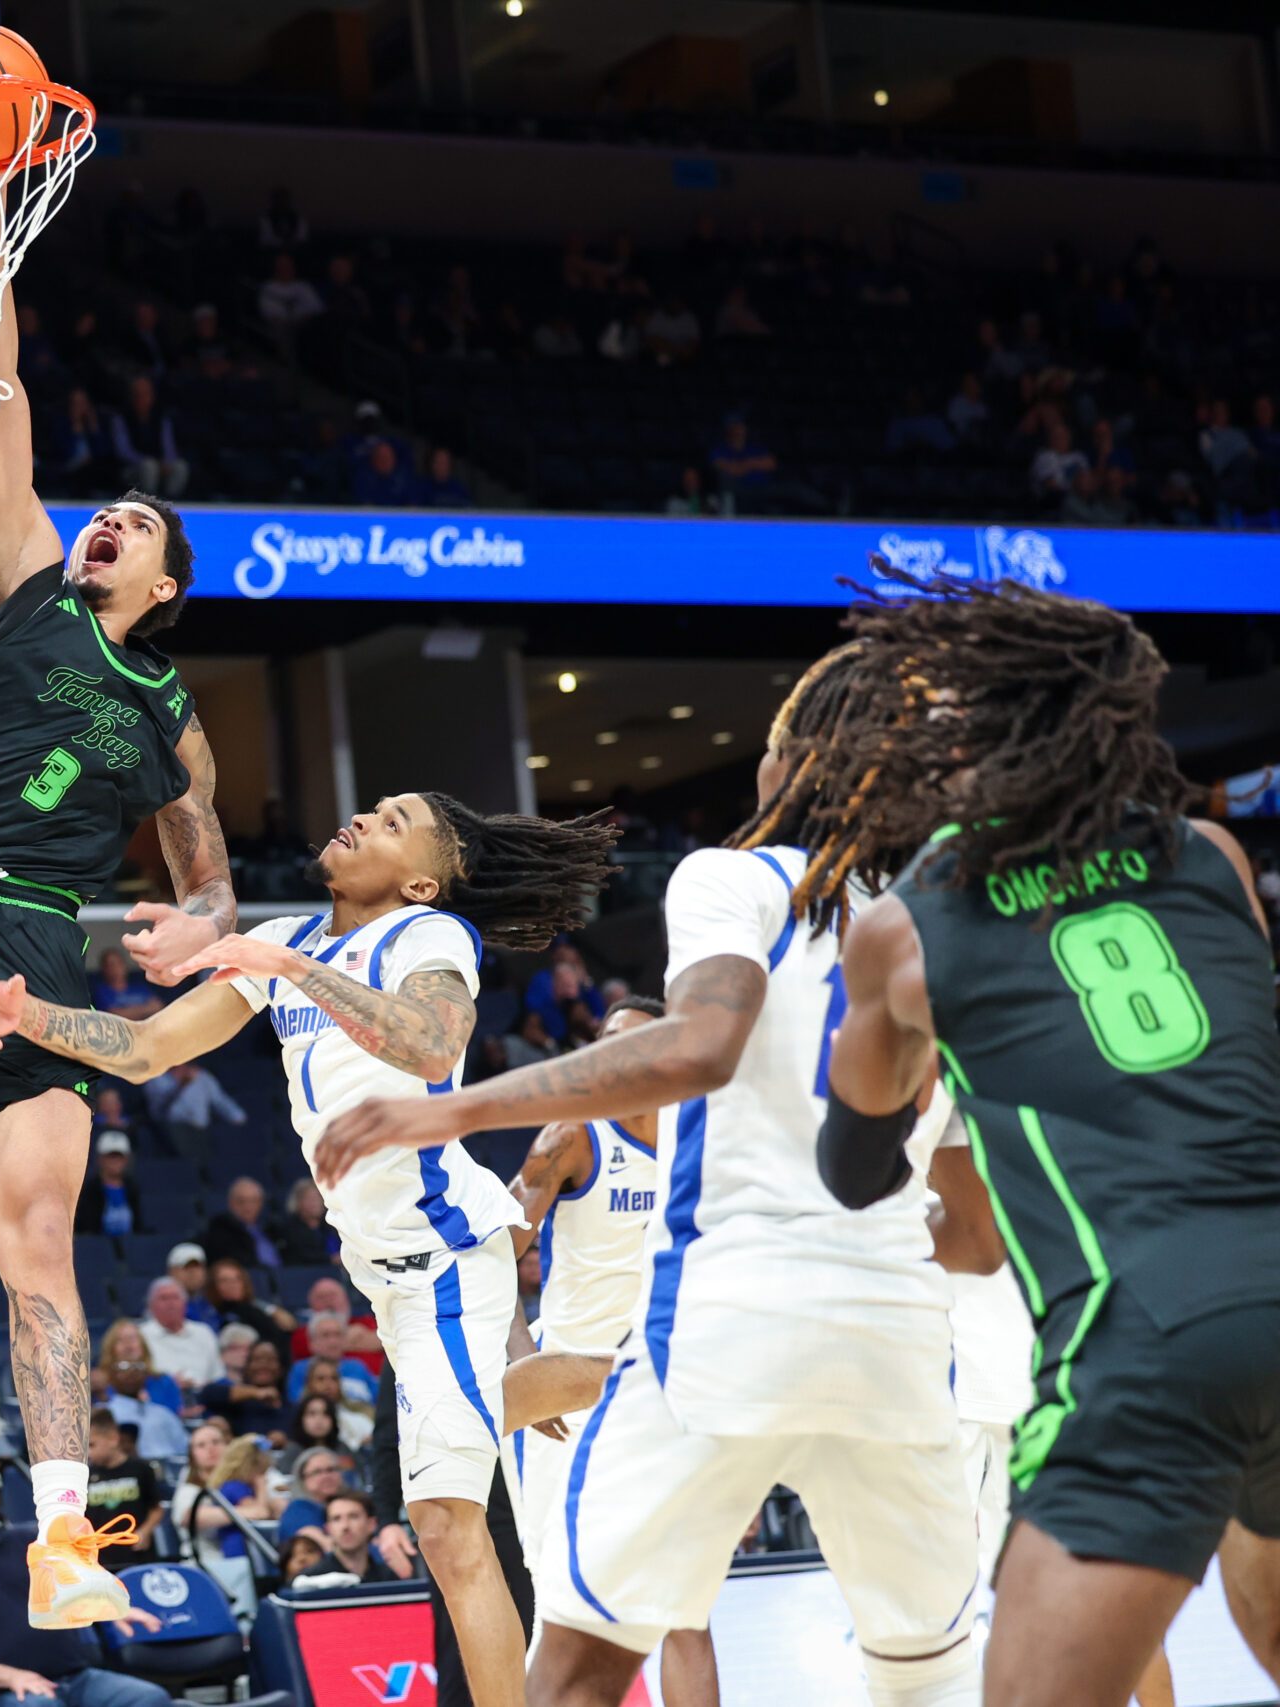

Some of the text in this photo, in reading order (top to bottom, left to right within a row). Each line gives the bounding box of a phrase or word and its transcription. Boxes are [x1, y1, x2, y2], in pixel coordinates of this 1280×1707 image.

[233, 522, 526, 599] Sissy's Log Cabin
[38, 667, 141, 727] Tampa
[72, 715, 141, 769] Bay
[21, 747, 81, 811] 3
[1049, 902, 1211, 1074] 8
